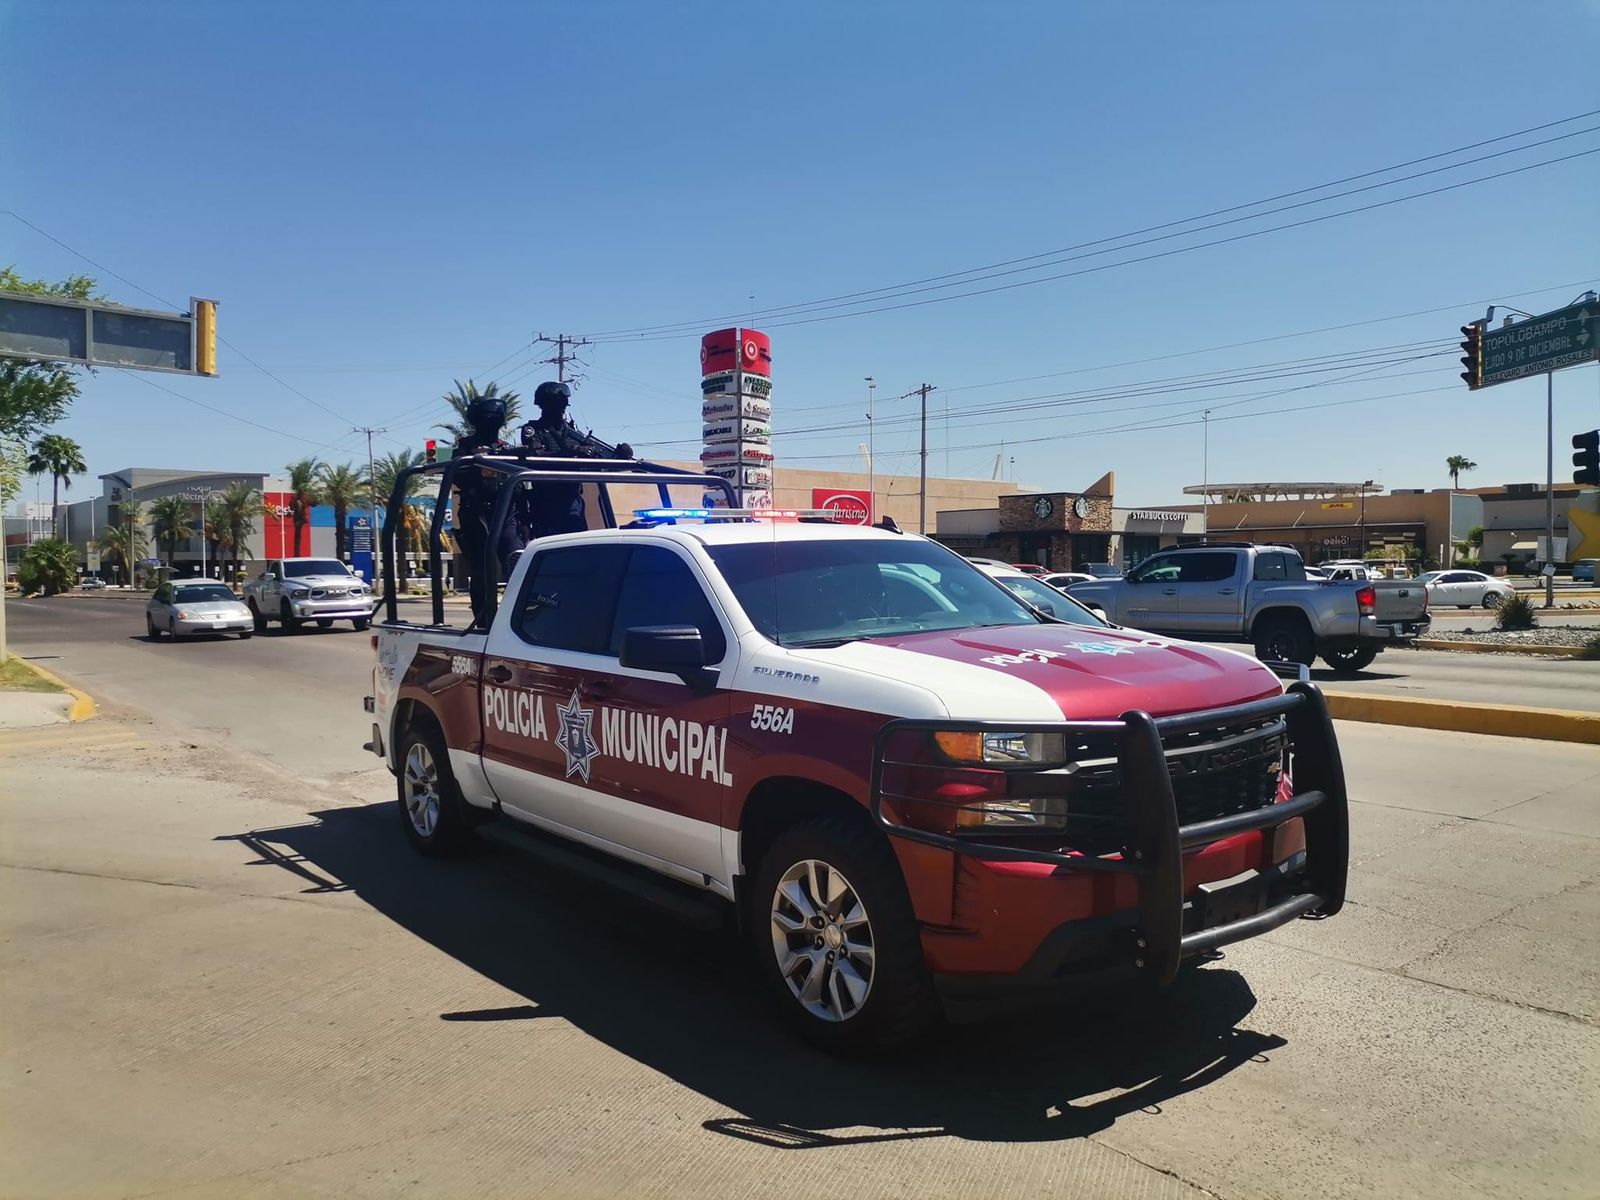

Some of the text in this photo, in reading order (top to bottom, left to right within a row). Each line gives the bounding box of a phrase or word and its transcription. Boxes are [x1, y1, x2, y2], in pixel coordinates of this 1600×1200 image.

[1486, 317, 1567, 351] TOPOLOBAMPO
[1507, 350, 1513, 363] 9
[1515, 346, 1526, 360] DE
[1528, 335, 1572, 358] DICIEMBRE
[1524, 358, 1554, 374] ANTONIO
[1556, 348, 1593, 365] ROSALES
[1131, 511, 1168, 520] STARBUCKS
[750, 703, 795, 735] 556A
[484, 685, 733, 787] POLICÍA MUNICIPAL
